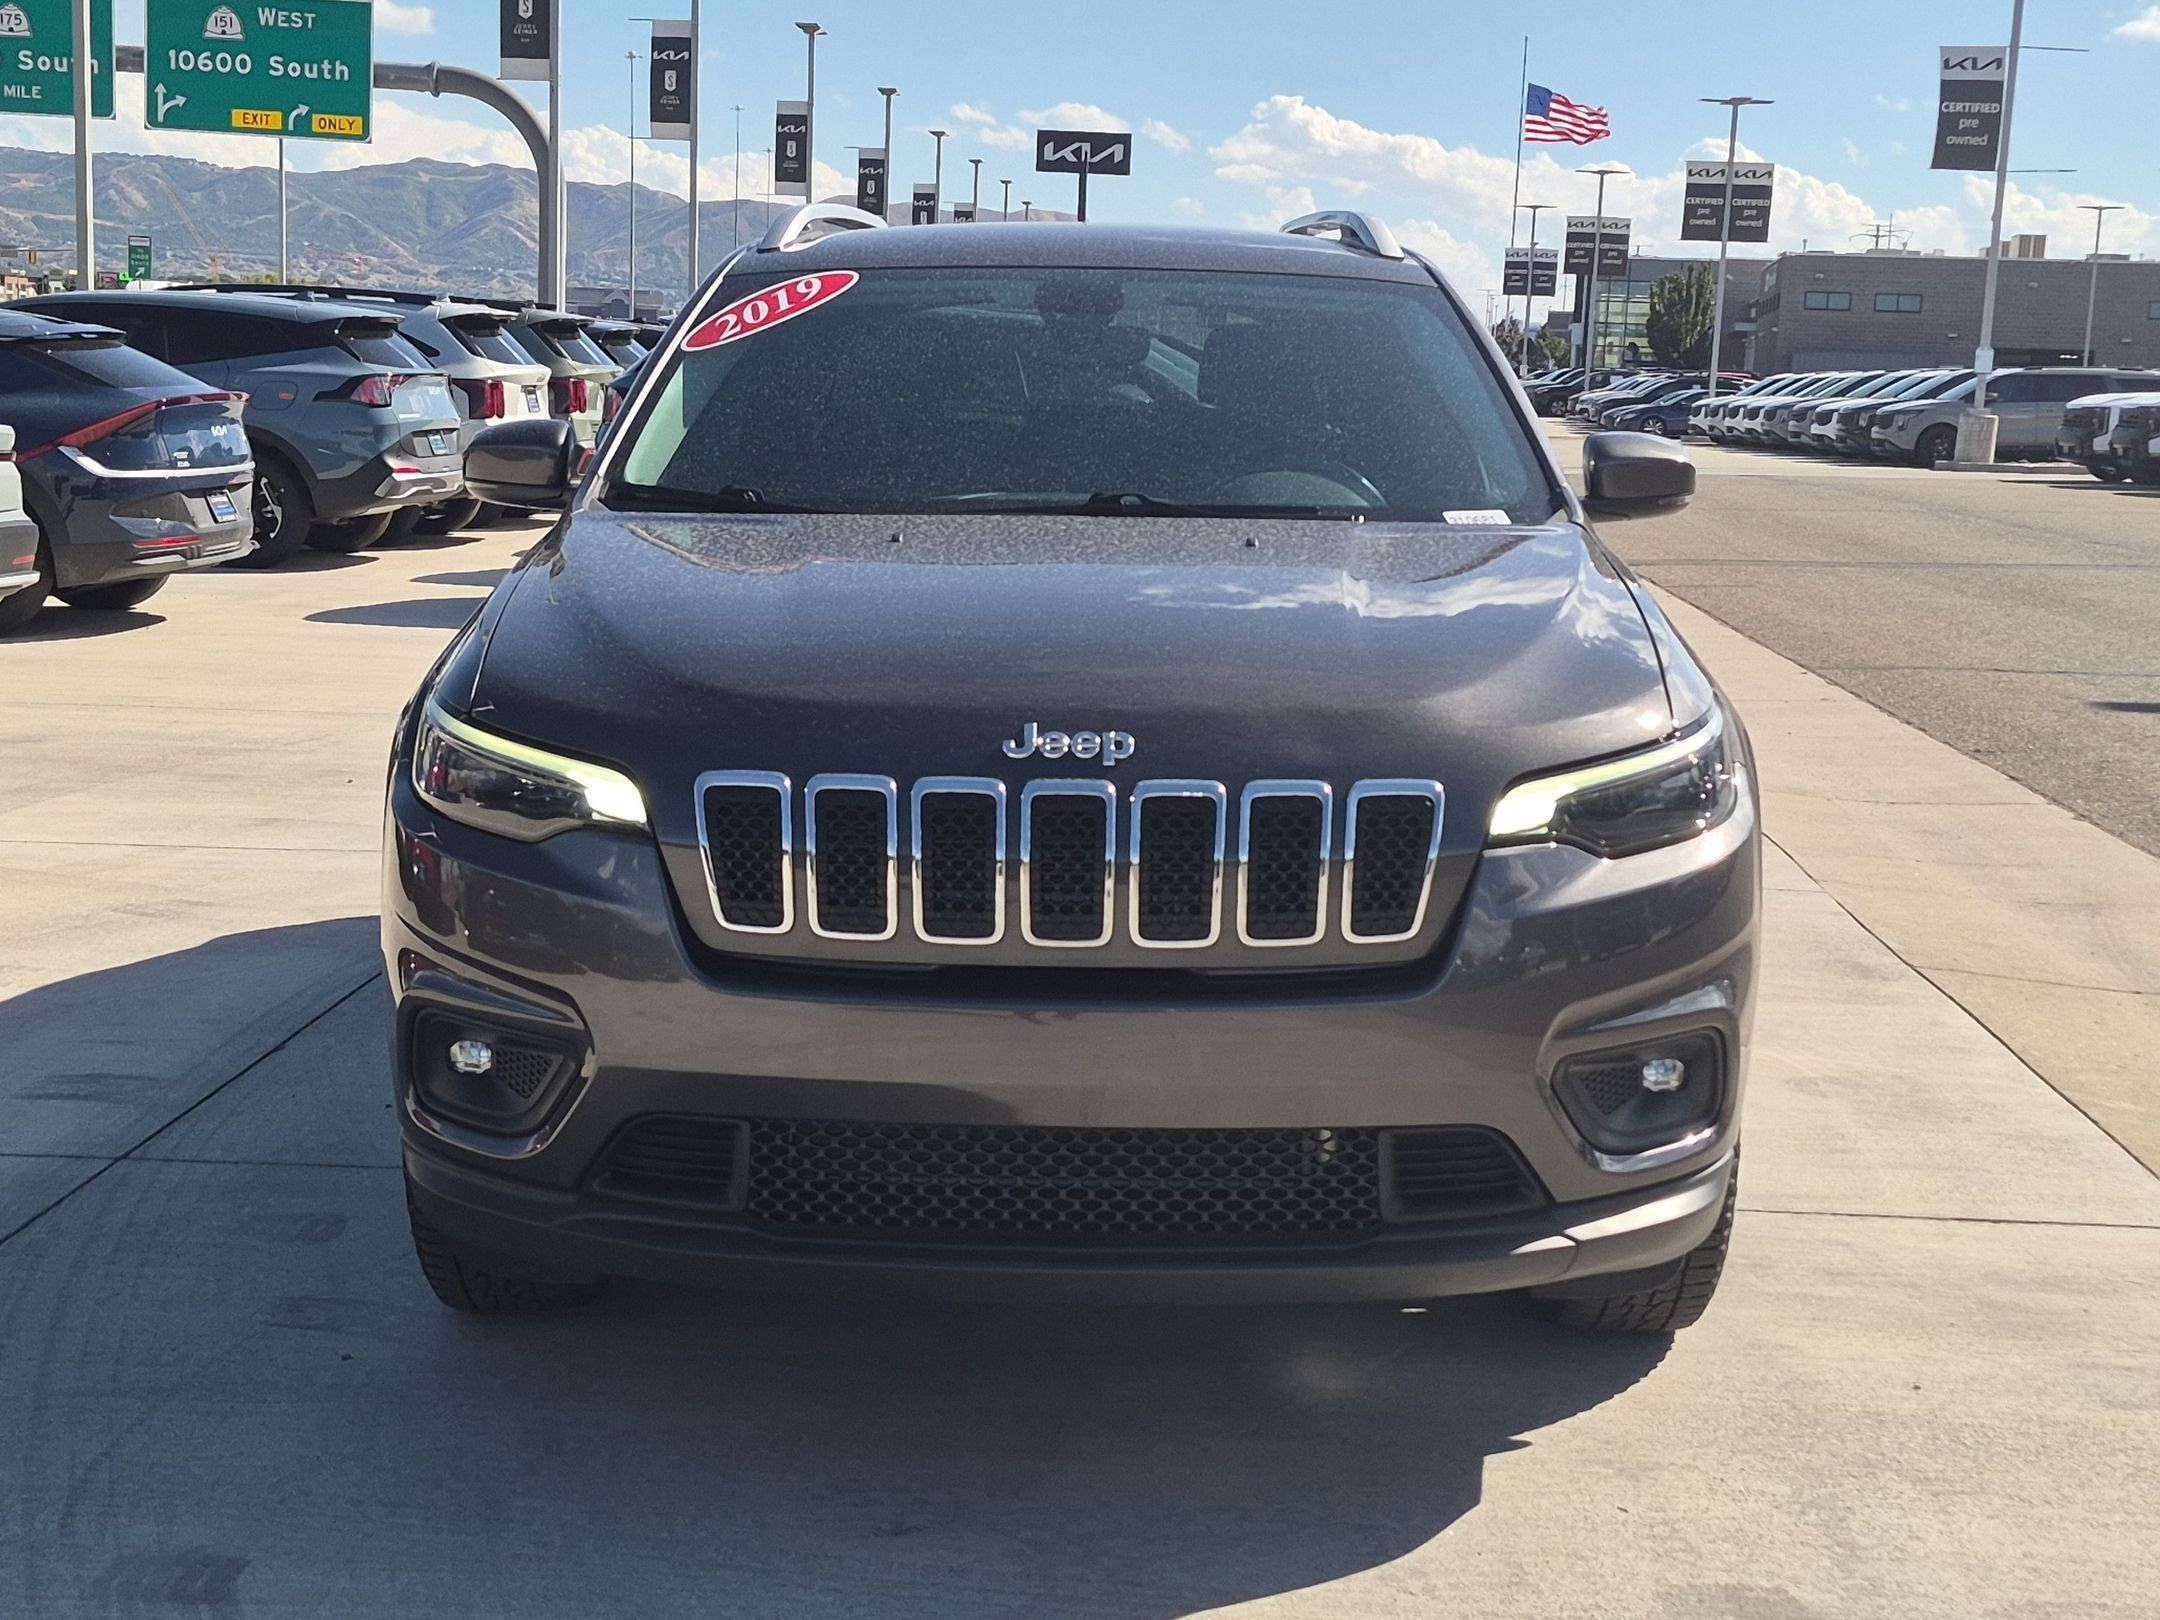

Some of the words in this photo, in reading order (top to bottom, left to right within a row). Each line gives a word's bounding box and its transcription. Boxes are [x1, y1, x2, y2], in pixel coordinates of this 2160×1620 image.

[214, 16, 233, 28] 151
[257, 7, 316, 29] WEST
[652, 50, 690, 61] KIA
[168, 49, 252, 75] 10600
[268, 55, 350, 81] South
[1943, 56, 2003, 71] KIA
[3, 84, 43, 99] MILE
[1941, 101, 2001, 114] CERTIFIED
[242, 111, 271, 126] EXIT
[318, 117, 356, 131] ONLY
[1958, 118, 1980, 130] pre
[1946, 133, 1989, 146] owned
[1043, 141, 1125, 164] KIA
[1688, 168, 1727, 178] KIA
[1734, 169, 1772, 179] KIA
[714, 277, 823, 341] 2019
[1002, 721, 1136, 767] Jeep
